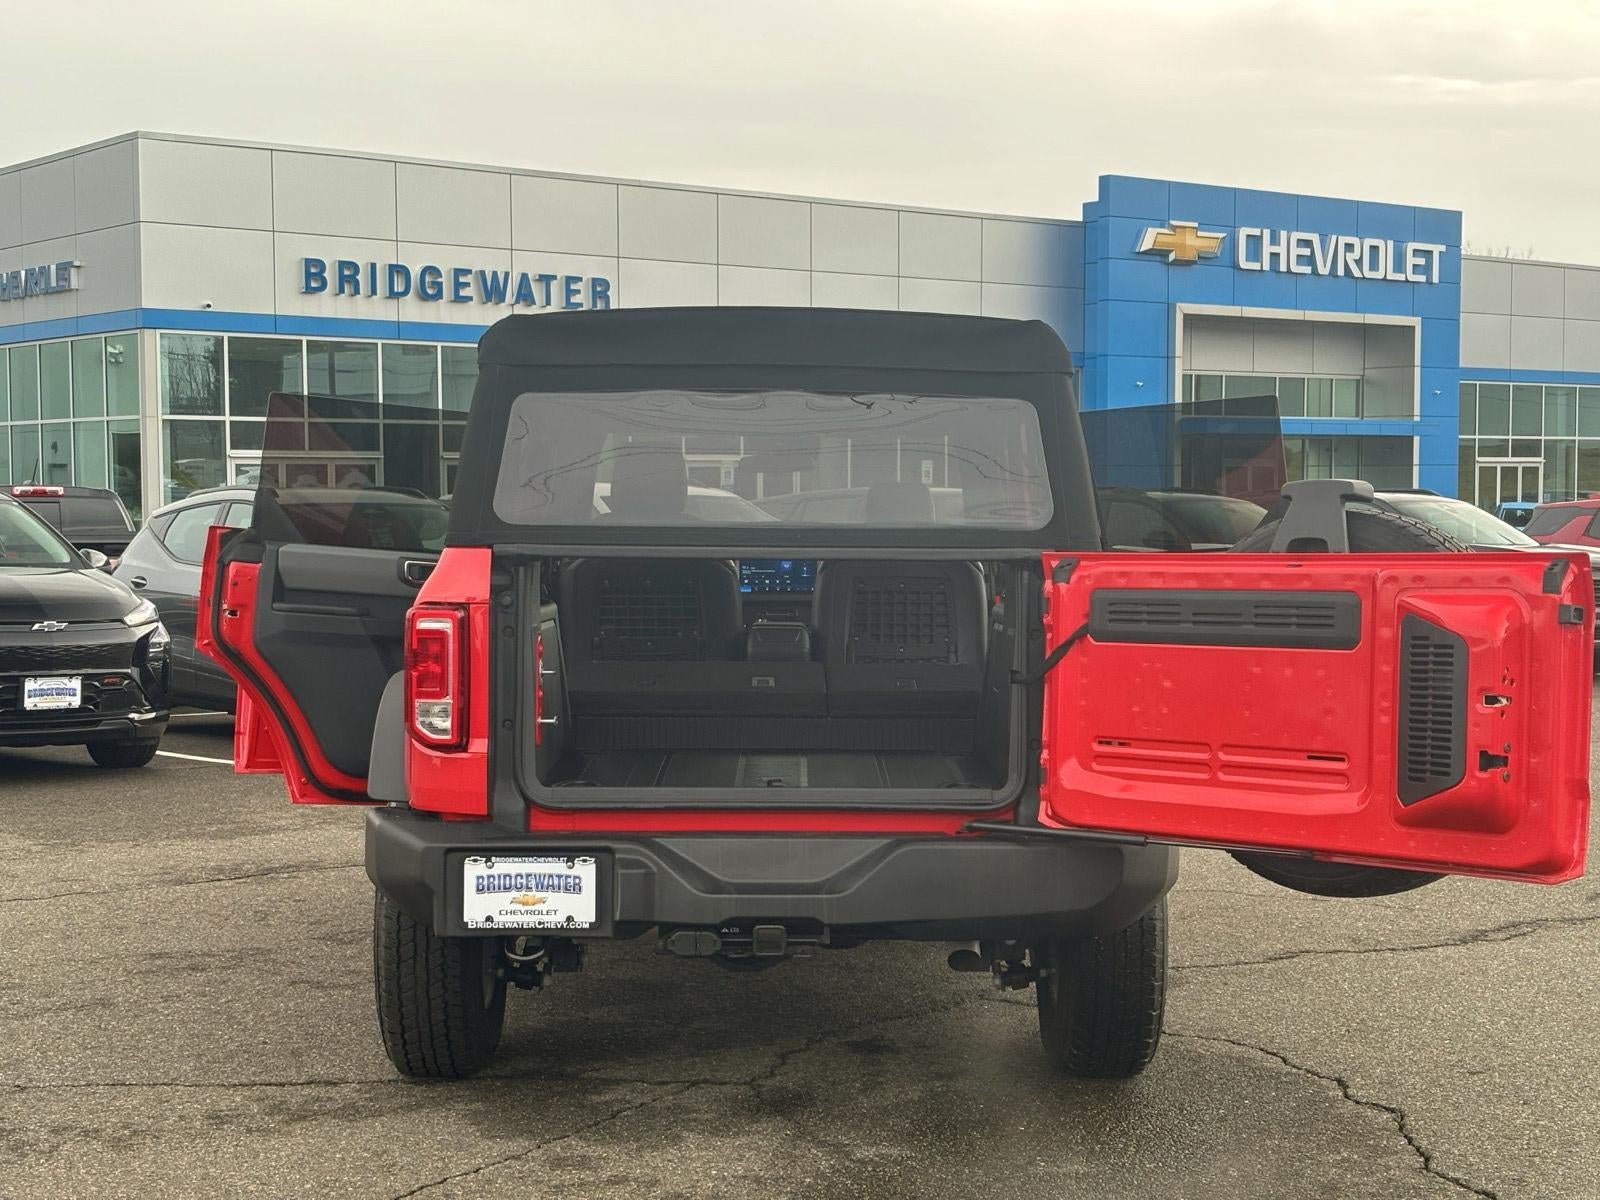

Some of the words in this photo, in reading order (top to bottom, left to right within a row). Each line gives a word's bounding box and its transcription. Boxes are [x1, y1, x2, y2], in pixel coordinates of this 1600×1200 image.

[1238, 226, 1447, 283] CHEVROLET
[301, 257, 611, 310] BRIDGEWATER
[475, 872, 582, 894] BRIDGEWATER
